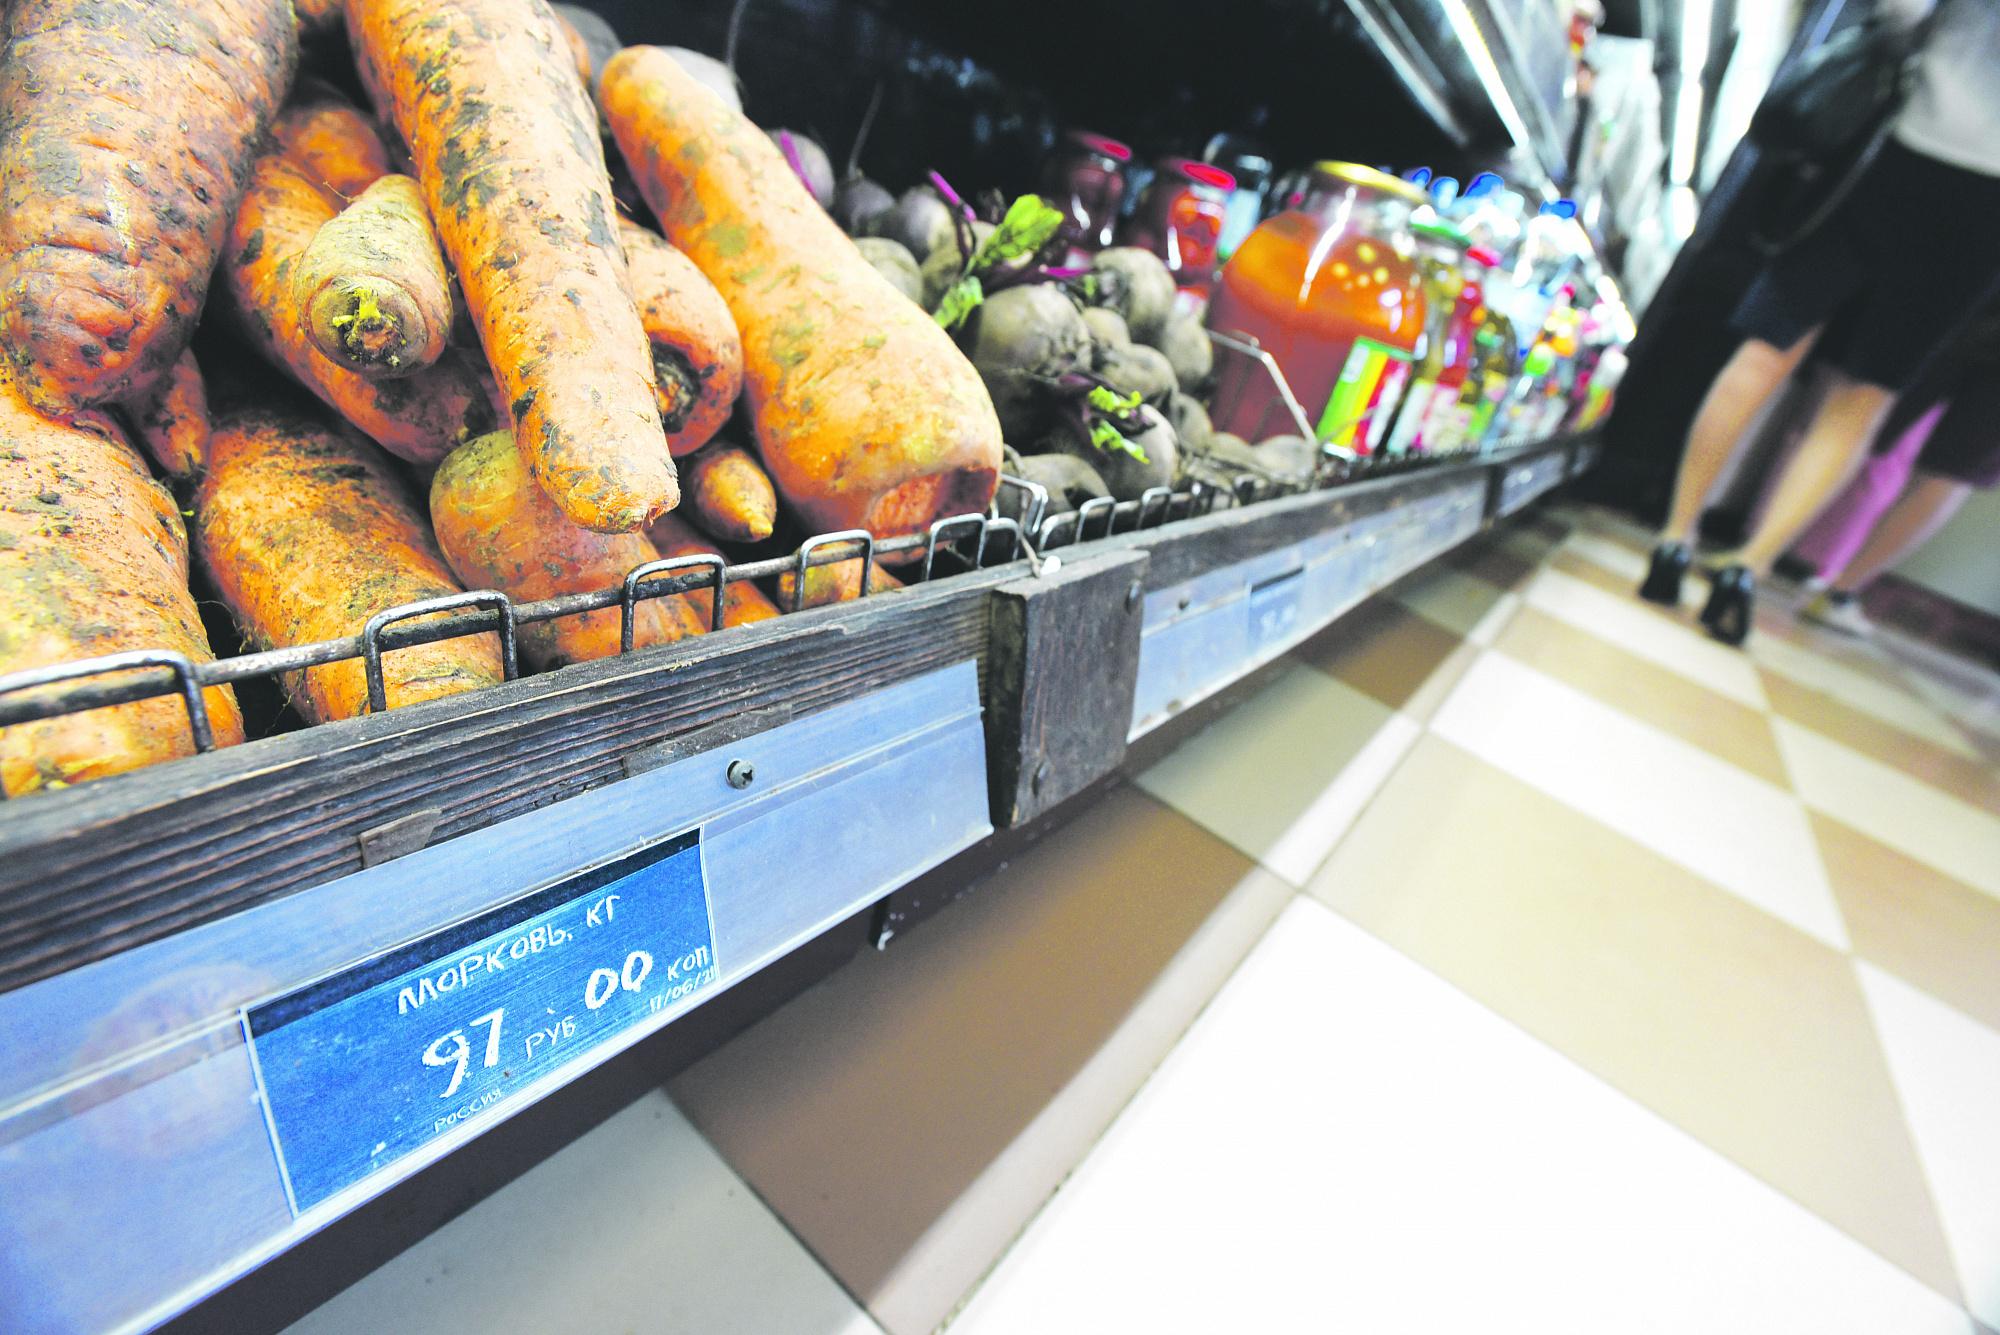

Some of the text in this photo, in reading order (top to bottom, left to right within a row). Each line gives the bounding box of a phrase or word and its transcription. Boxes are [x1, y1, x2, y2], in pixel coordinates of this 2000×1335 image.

[398, 922, 573, 1015] МОРКОВЬ,
[421, 1007, 505, 1099] 97
[524, 1015, 577, 1062] РУБ
[584, 950, 653, 1010] 00
[433, 1088, 503, 1133] РОССИЯ
